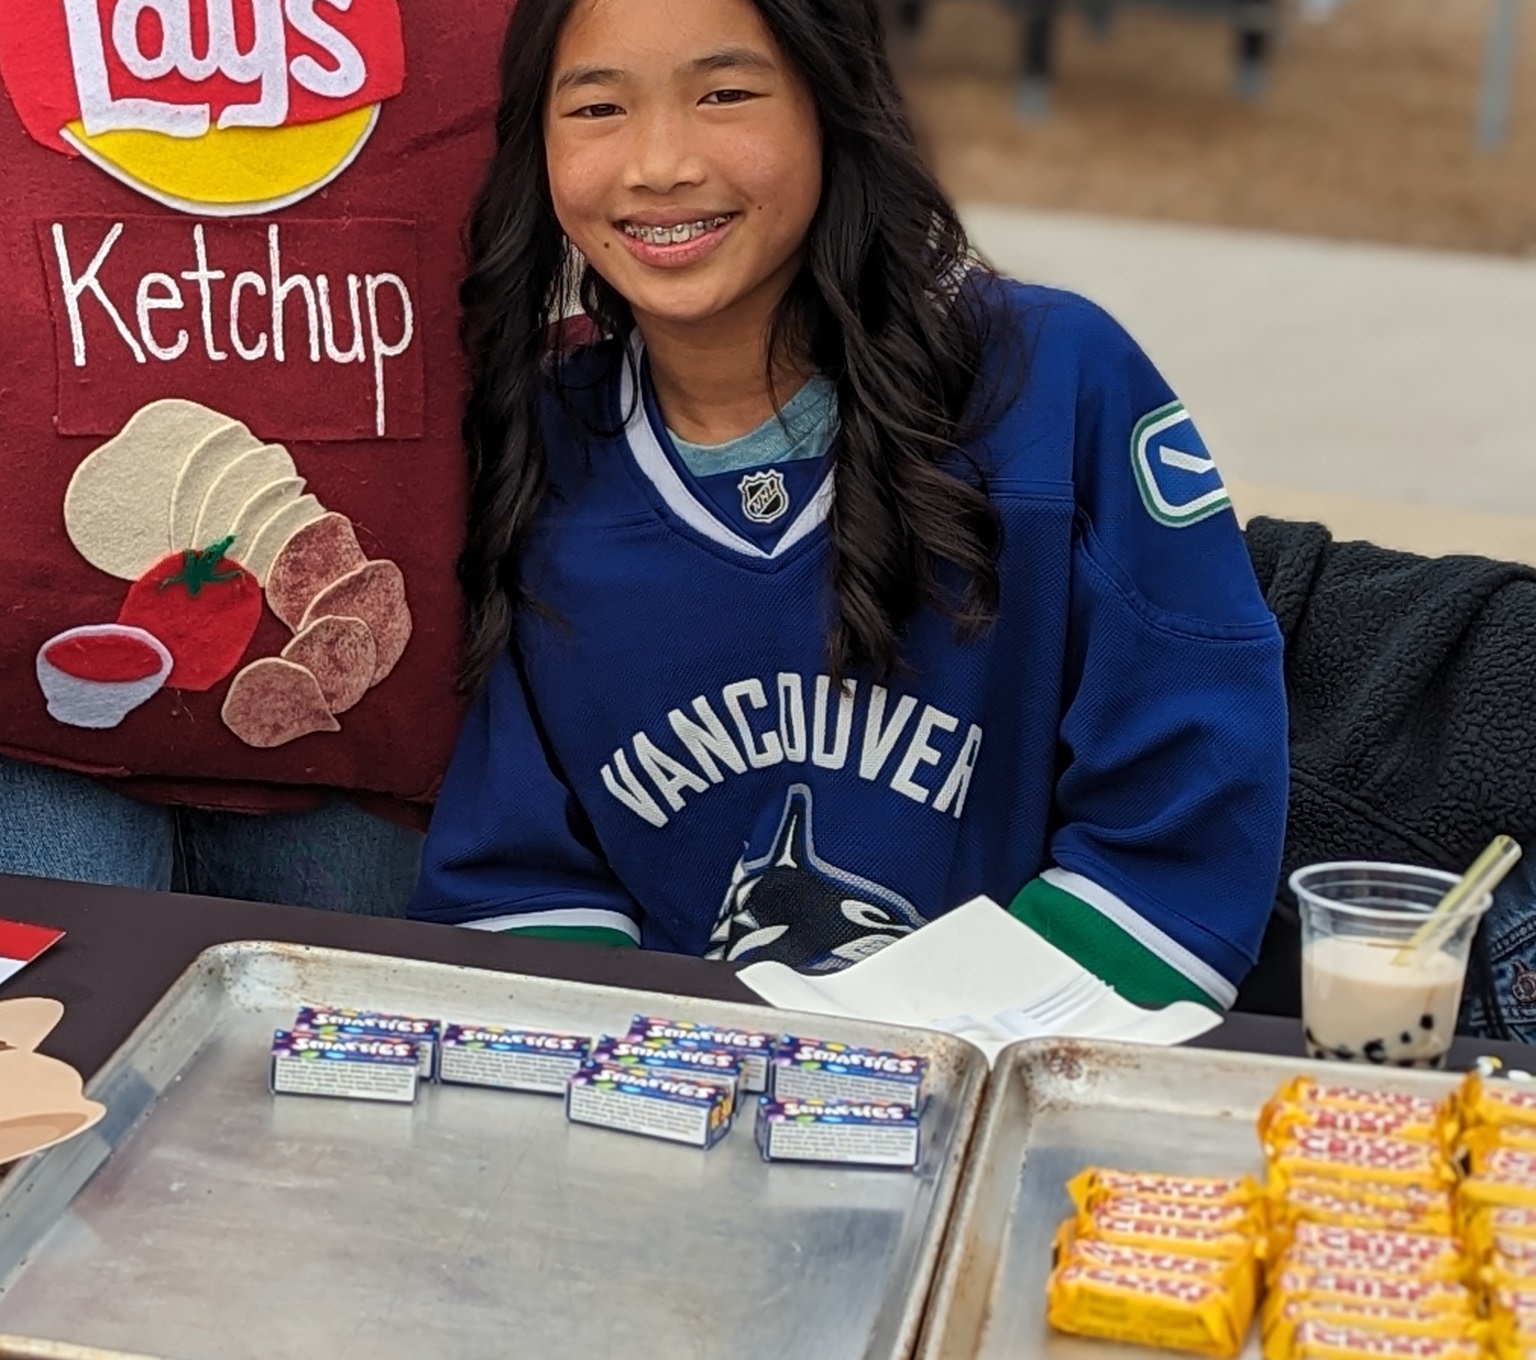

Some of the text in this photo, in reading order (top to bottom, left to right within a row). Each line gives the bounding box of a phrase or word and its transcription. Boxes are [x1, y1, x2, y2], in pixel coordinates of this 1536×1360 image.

[51, 222, 415, 438] Ketchup
[752, 482, 776, 515] NHL
[599, 671, 984, 829] VANCOUVER
